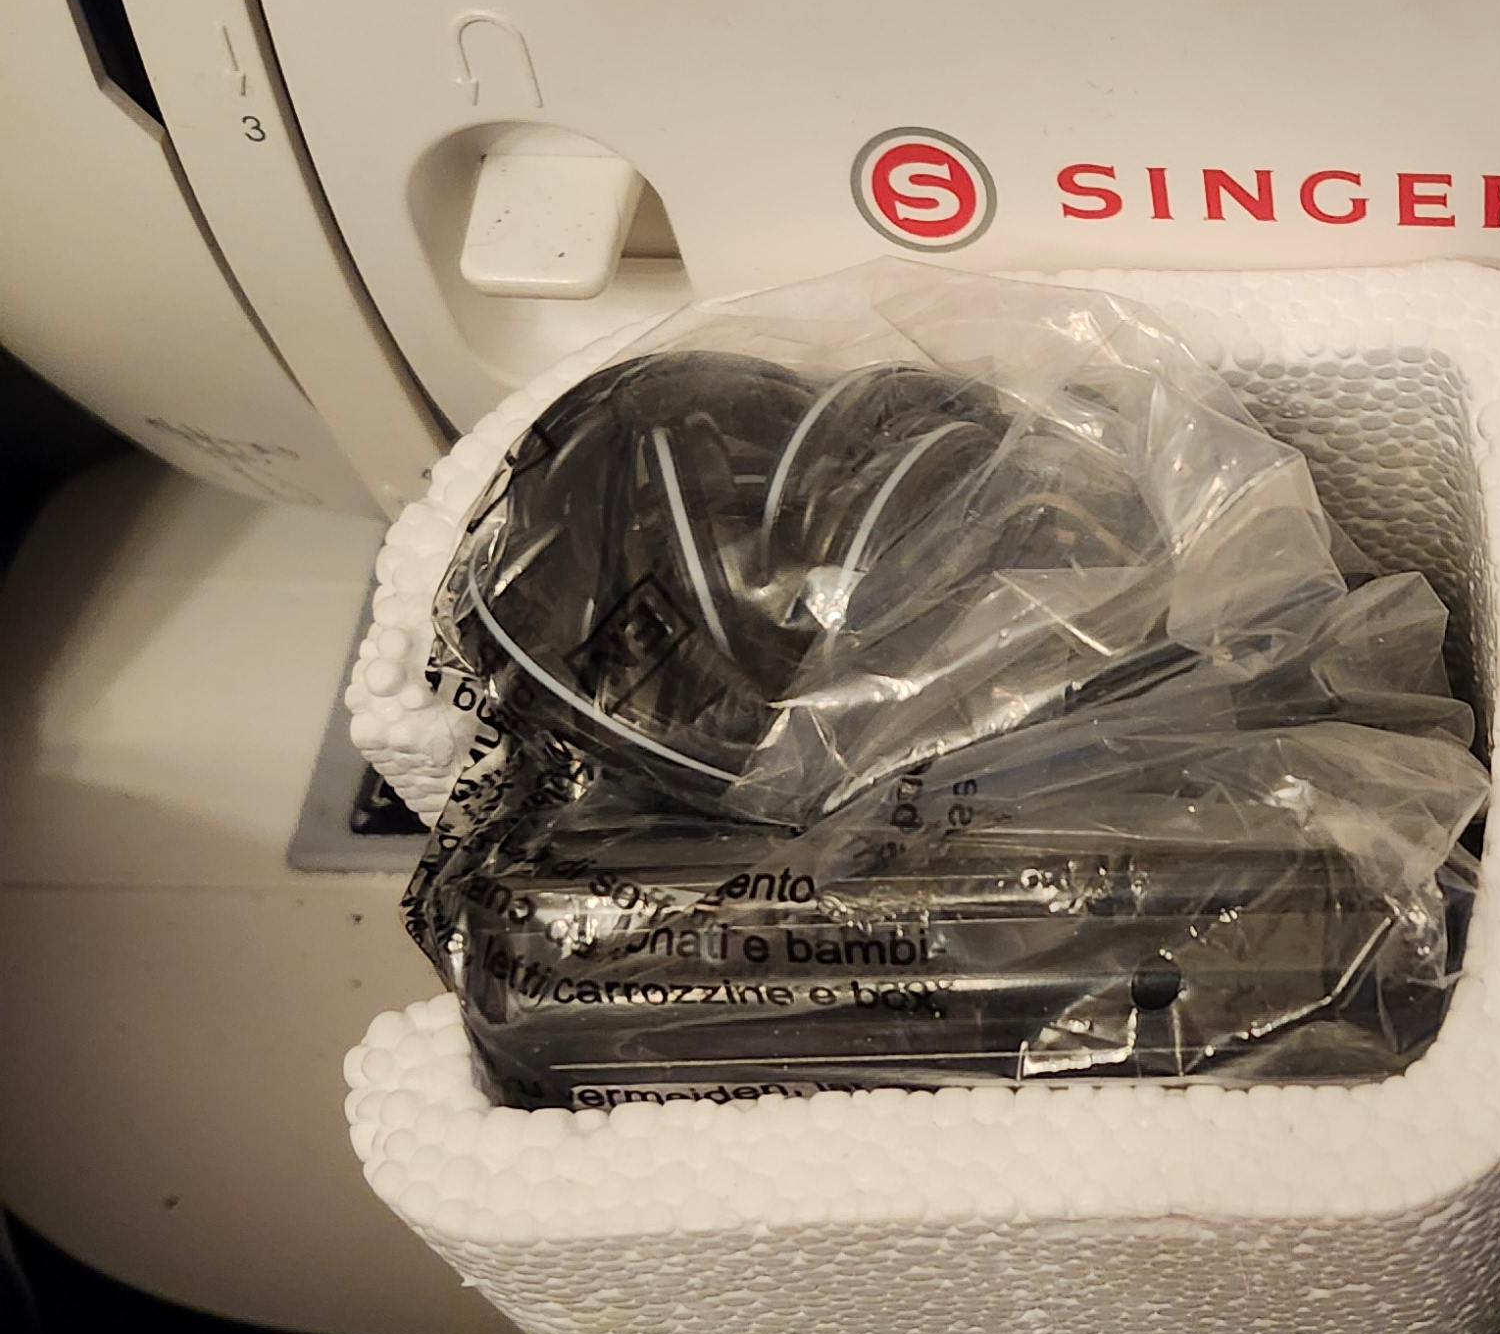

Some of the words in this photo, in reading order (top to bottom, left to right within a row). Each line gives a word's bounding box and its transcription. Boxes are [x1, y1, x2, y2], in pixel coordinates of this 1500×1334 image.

[242, 115, 266, 143] 3
[743, 934, 770, 964] e
[786, 928, 946, 966] bambi-
[553, 977, 795, 1006] carrozzine
[808, 983, 837, 1007] e
